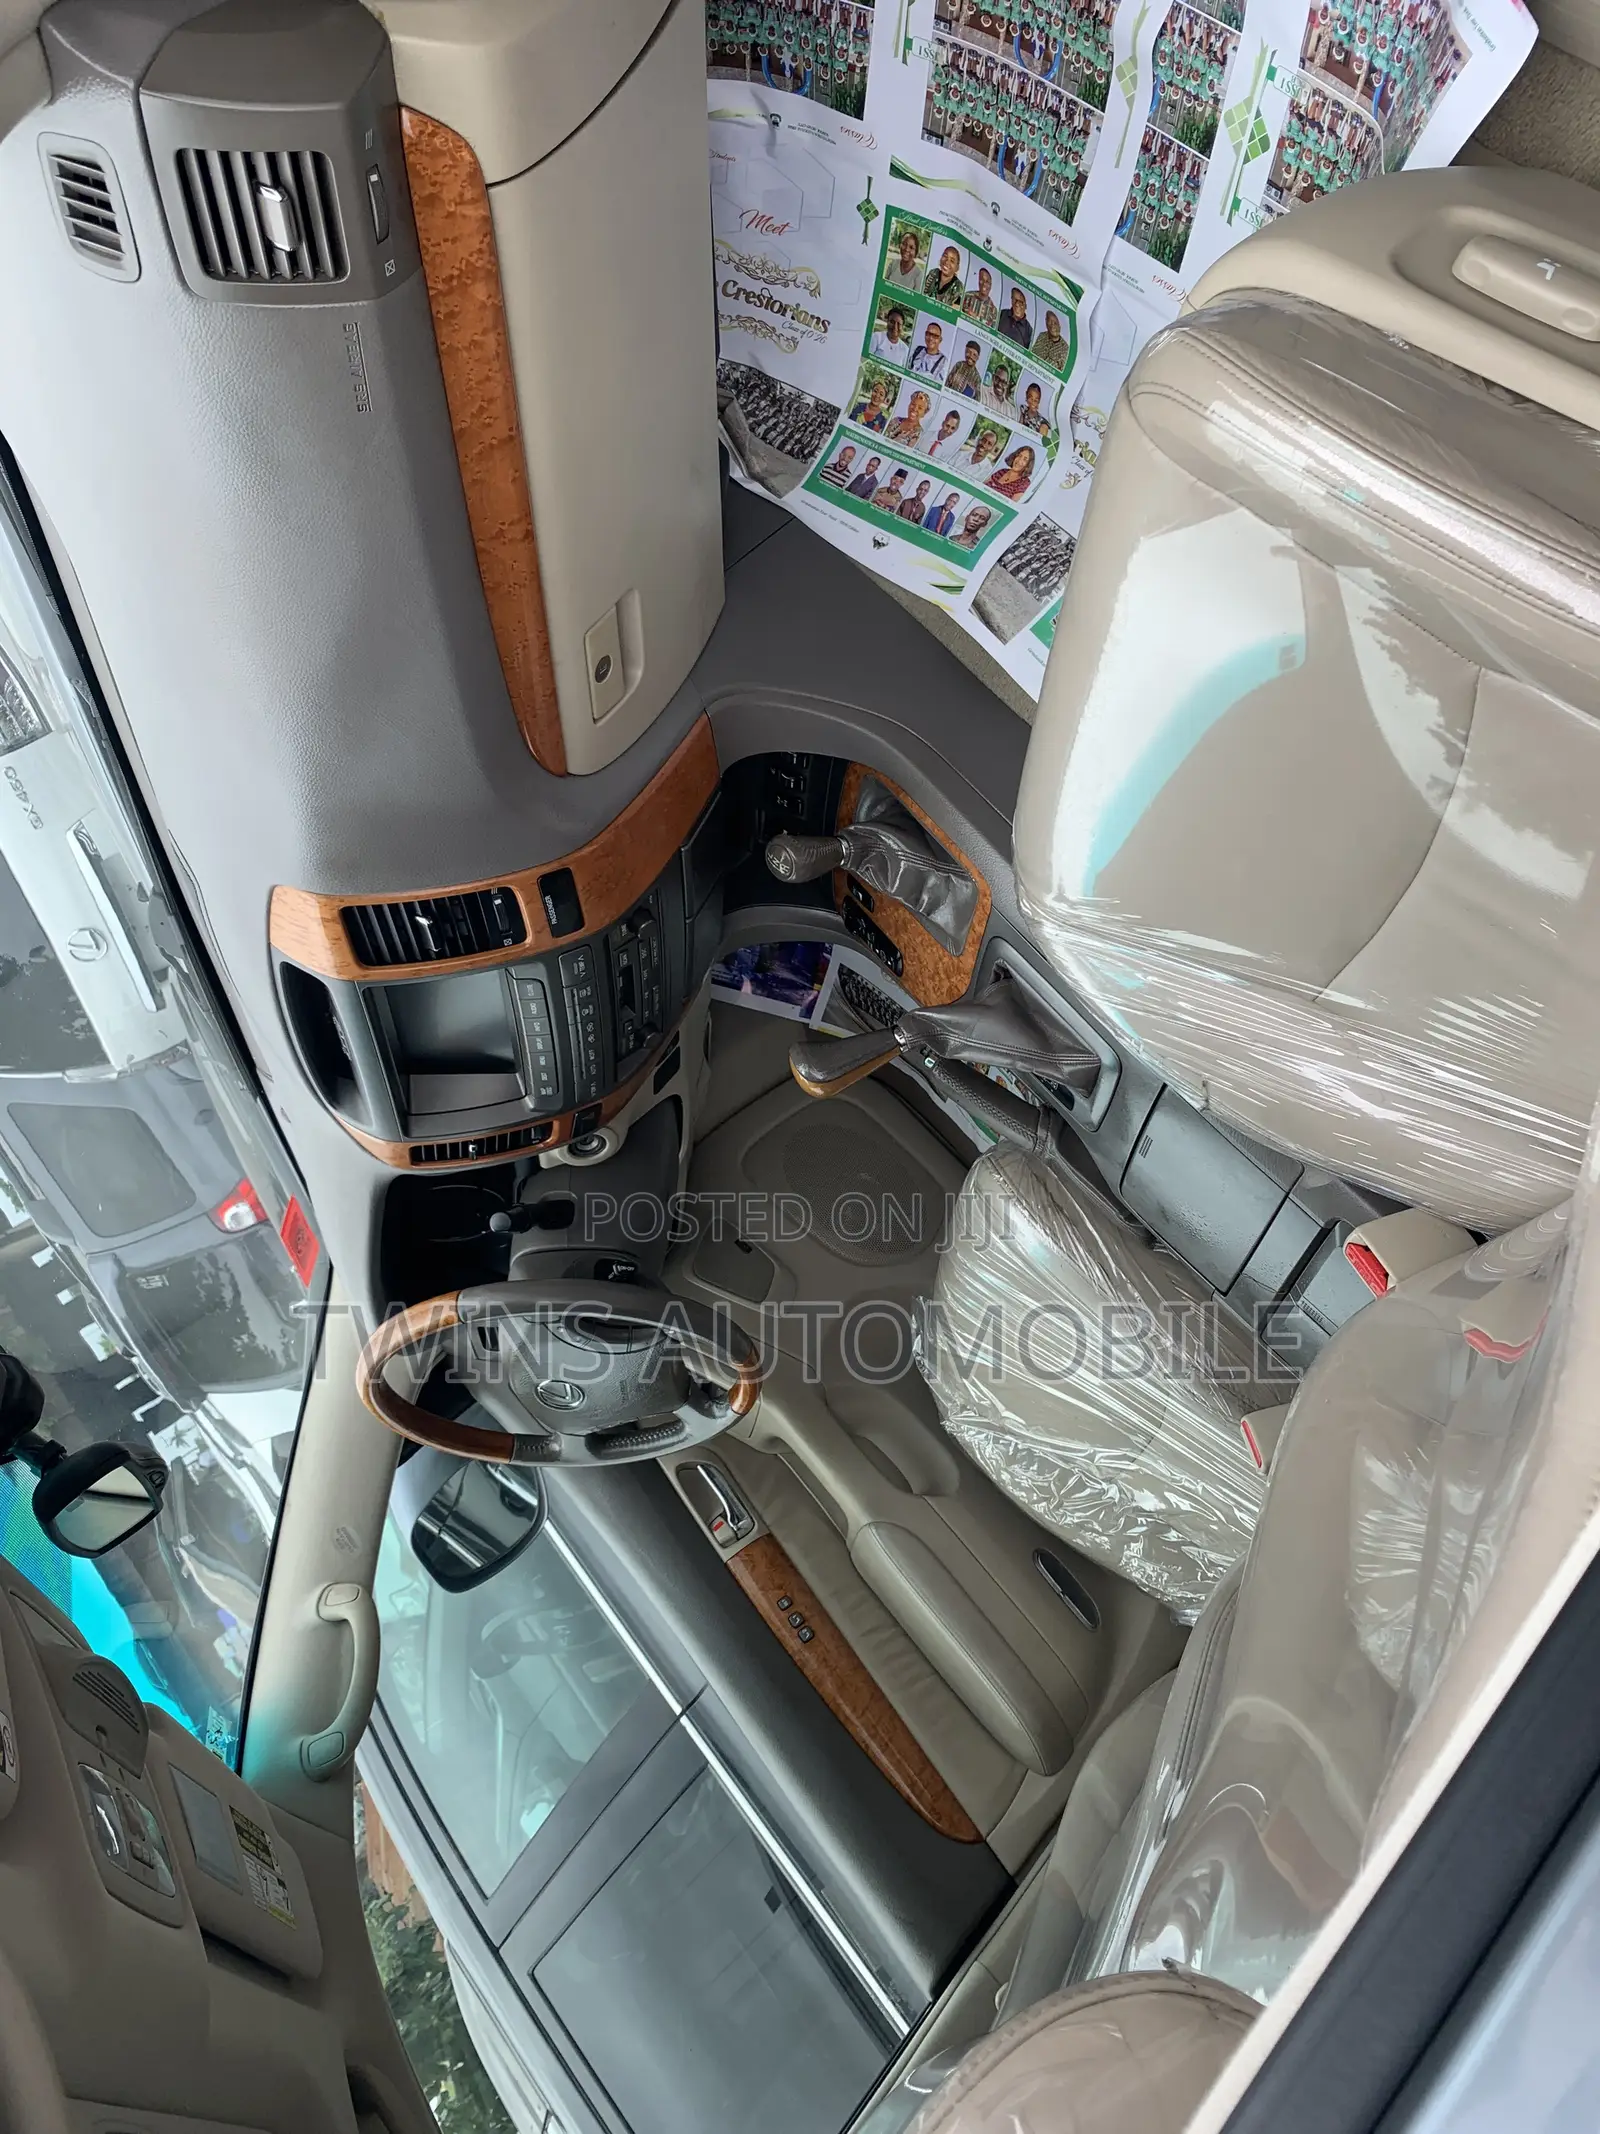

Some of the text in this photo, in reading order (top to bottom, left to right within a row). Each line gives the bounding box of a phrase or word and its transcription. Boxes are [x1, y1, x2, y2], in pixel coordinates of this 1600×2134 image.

[739, 209, 792, 236] Meet
[721, 279, 832, 334] Crestorians
[343, 322, 369, 412] SRS AIRBAG
[545, 895, 557, 925] PASSENGER
